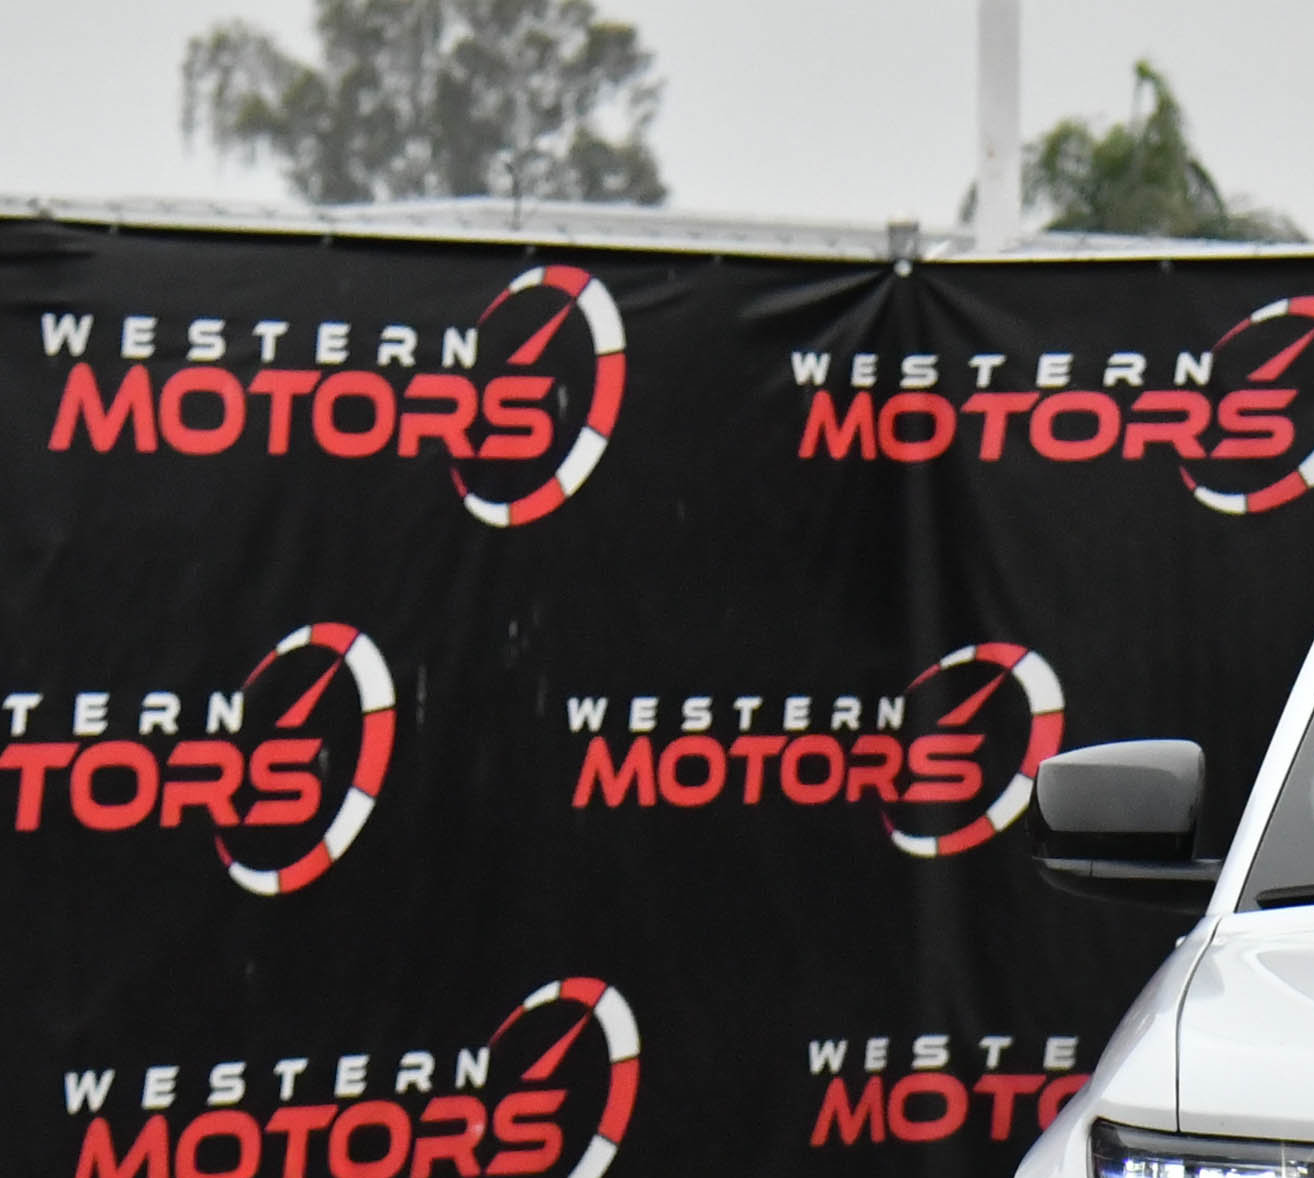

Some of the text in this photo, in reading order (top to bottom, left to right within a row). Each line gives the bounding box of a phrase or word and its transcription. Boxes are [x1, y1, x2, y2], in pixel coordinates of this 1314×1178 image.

[41, 313, 479, 367] WESTERN
[791, 351, 1213, 389] WESTERN
[48, 362, 555, 460] MOTORS
[798, 388, 1298, 463] MOTORS
[2, 691, 244, 737] TERN
[567, 696, 905, 732] WESTERN
[0, 738, 323, 832] TORS
[571, 733, 986, 809] MOTORS
[65, 1047, 490, 1115] WESTERN
[808, 1034, 1079, 1075] WESTE
